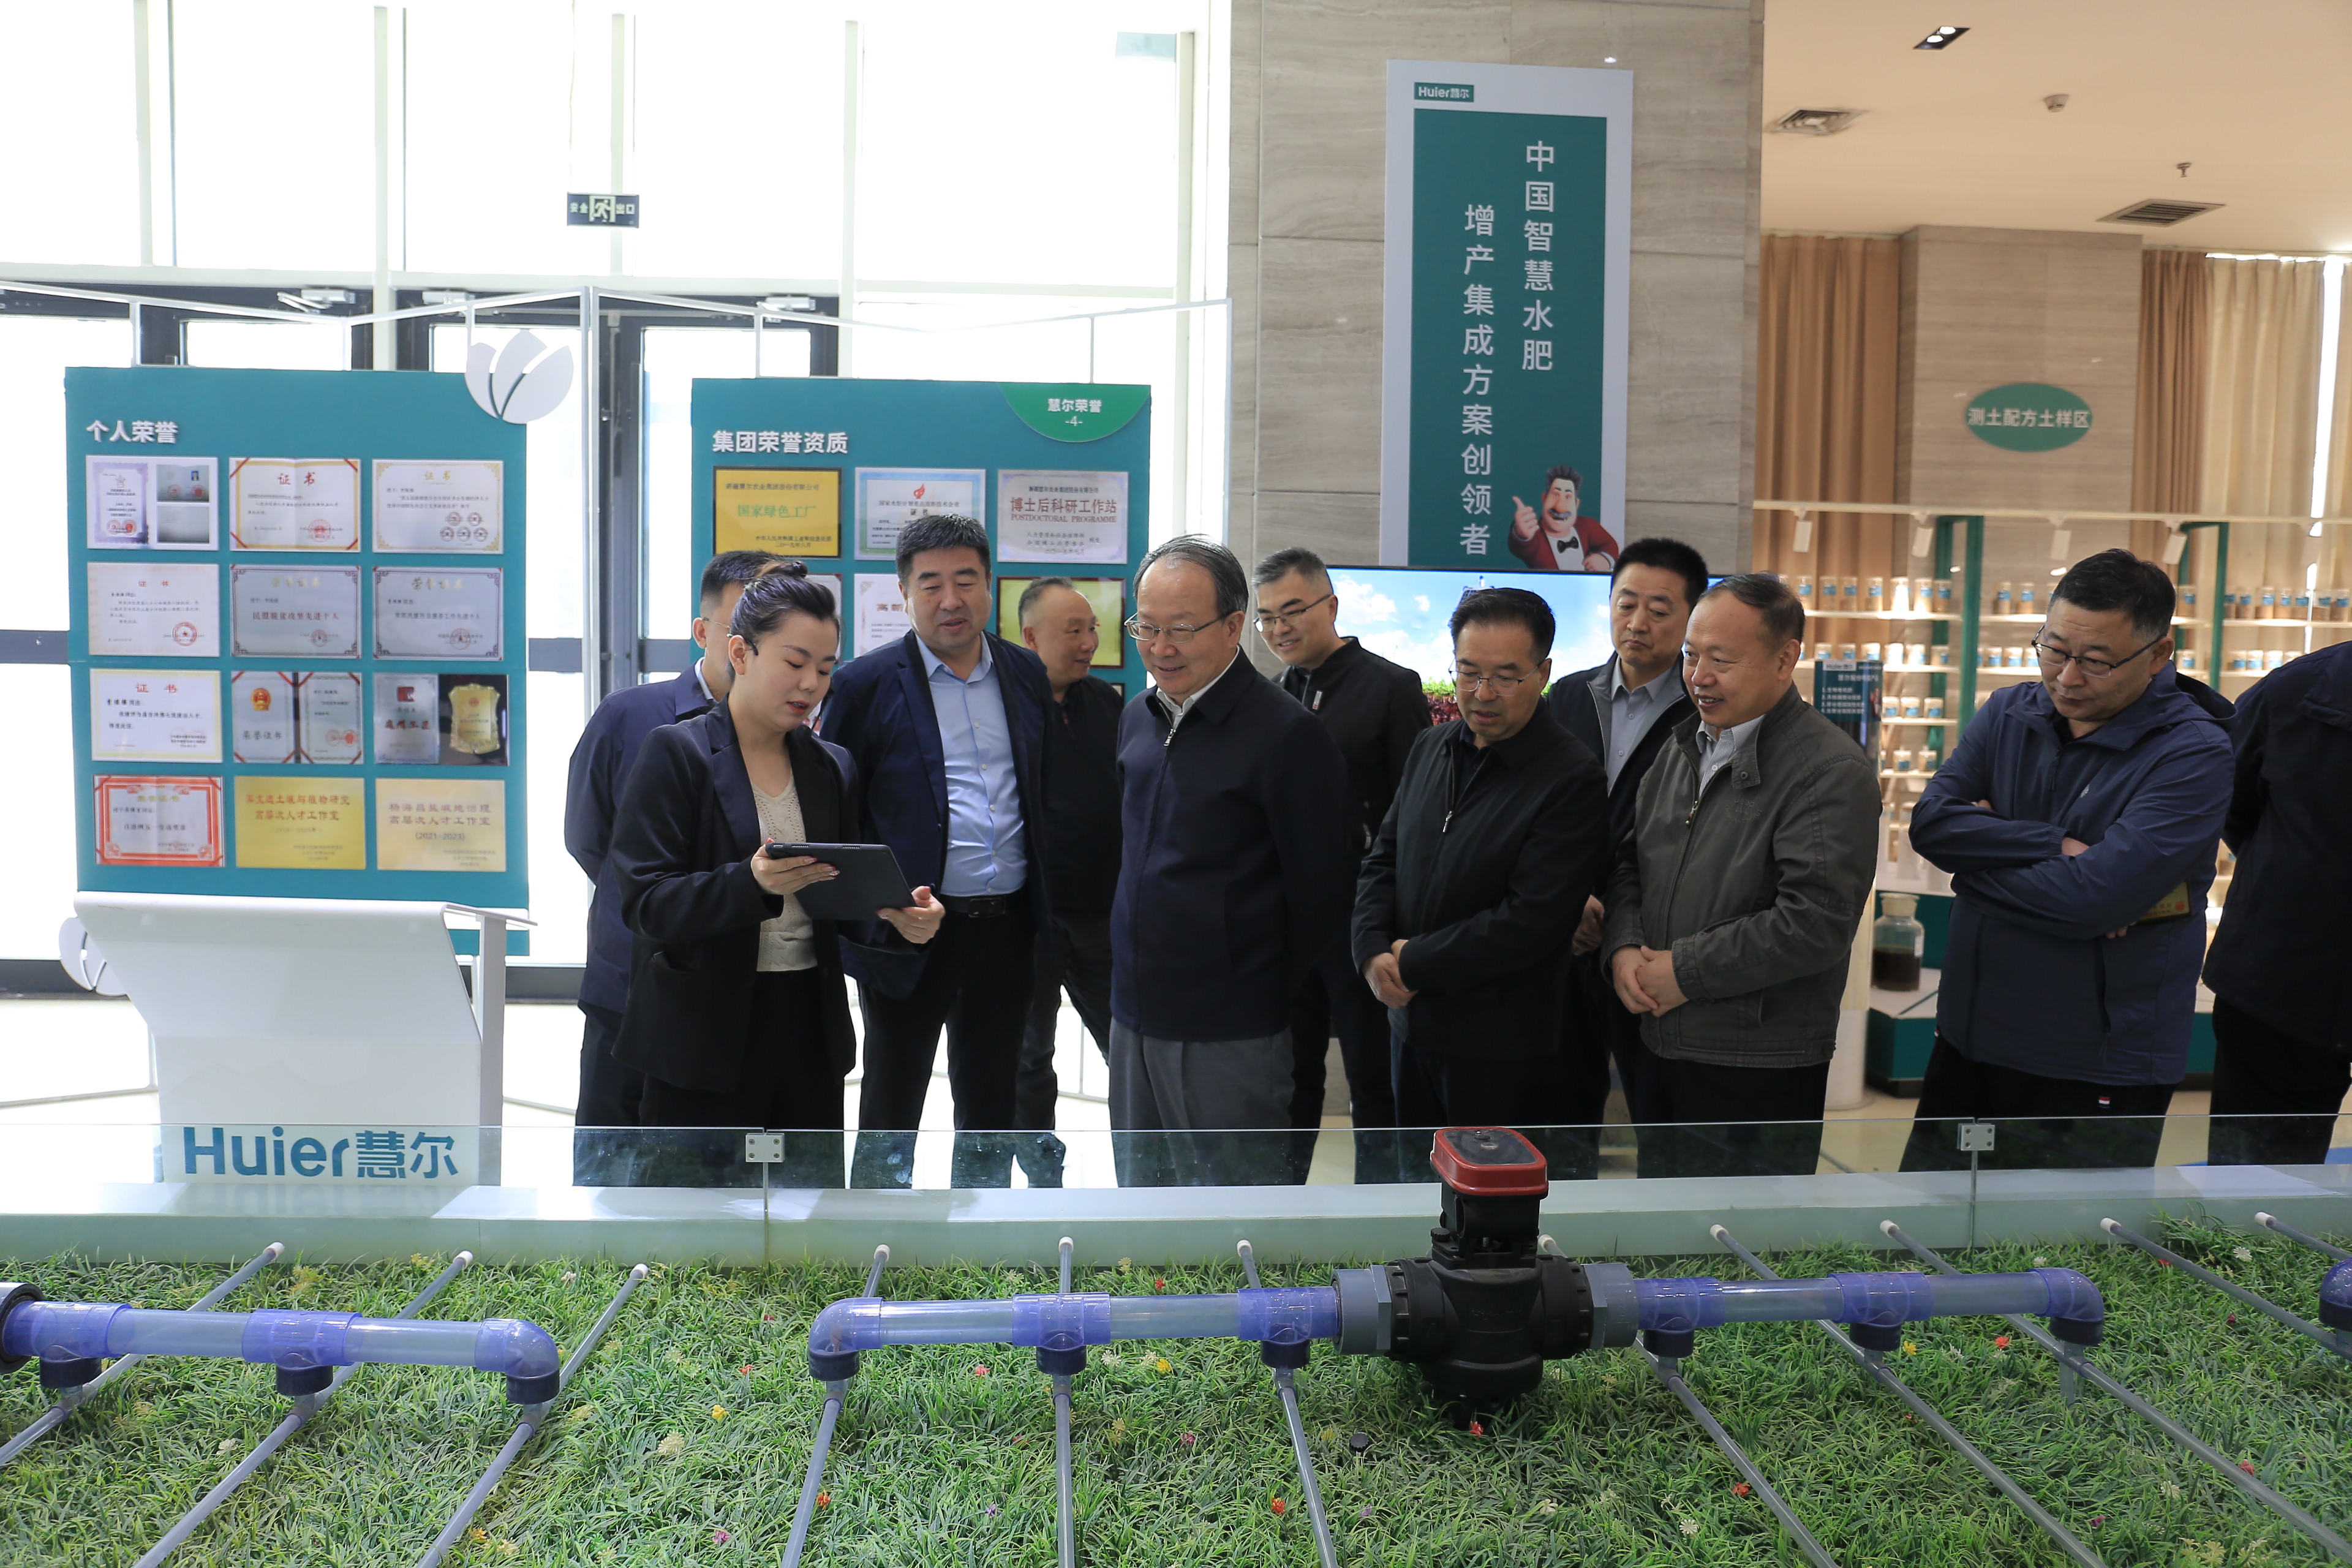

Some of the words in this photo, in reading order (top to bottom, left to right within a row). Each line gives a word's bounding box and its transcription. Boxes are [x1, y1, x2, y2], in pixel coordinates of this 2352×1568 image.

[1418, 86, 1469, 99] Huier慧尔
[1522, 141, 1555, 372] 中国智慧水肥
[1460, 204, 1494, 556] 增产集成方案创领者
[1047, 398, 1102, 413] 慧尔荣誉
[1065, 416, 1083, 426] -4-
[1967, 408, 2091, 428] 测土配方土样区
[86, 420, 179, 444] 个人荣誉
[712, 431, 848, 454] 集团荣誉资质
[277, 472, 315, 486] 证书
[424, 470, 451, 481] 证书
[737, 504, 816, 518] 国家绿色工厂
[1011, 497, 1117, 513] 博士后科研工作站
[1011, 513, 1068, 522] POSTDOCTORAL
[135, 684, 178, 693] 证书
[243, 731, 282, 741] 荣誉证书
[388, 803, 491, 813] 杨海昌盐碱地治理
[255, 810, 340, 821] 高层次人才工作室
[388, 815, 491, 826] 高层次人才工作室
[183, 1126, 459, 1179] Huier慧尔
